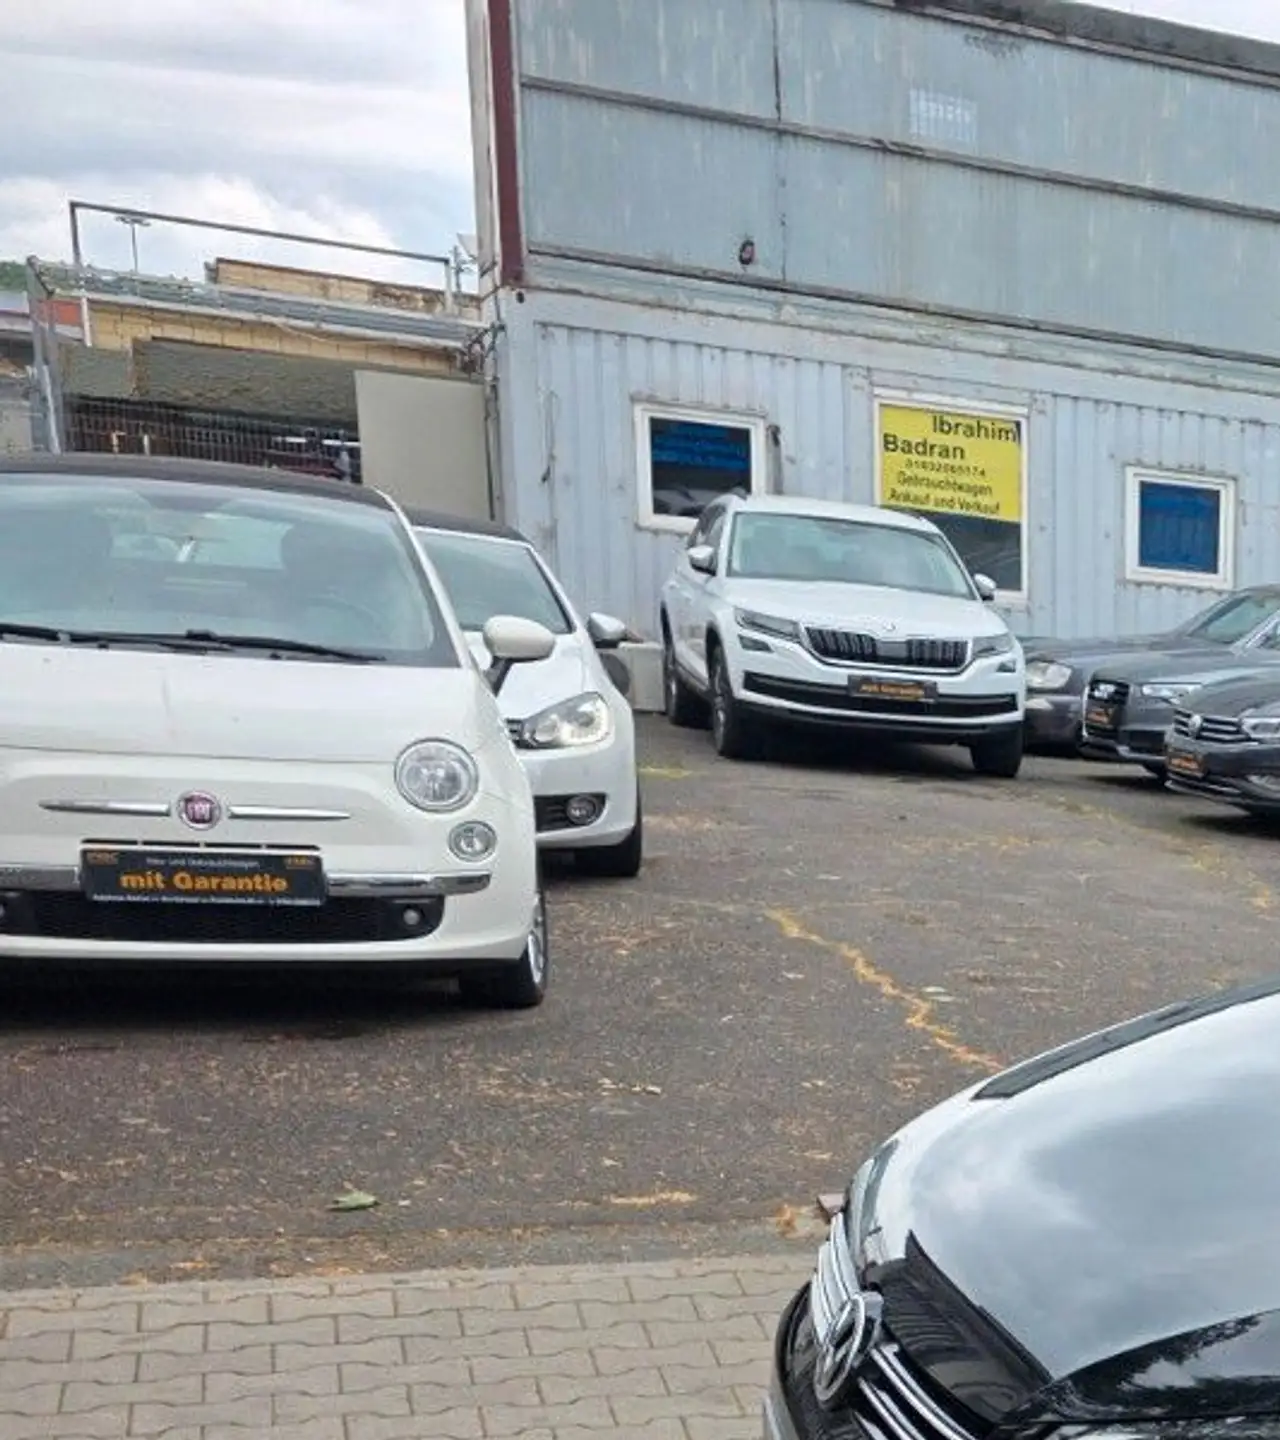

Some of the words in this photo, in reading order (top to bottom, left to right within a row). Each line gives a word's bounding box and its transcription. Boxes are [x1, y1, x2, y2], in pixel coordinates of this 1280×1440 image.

[932, 415, 1017, 442] Ibrahim
[883, 432, 966, 460] Badran
[120, 869, 166, 890] mit
[173, 871, 287, 893] Garantie
